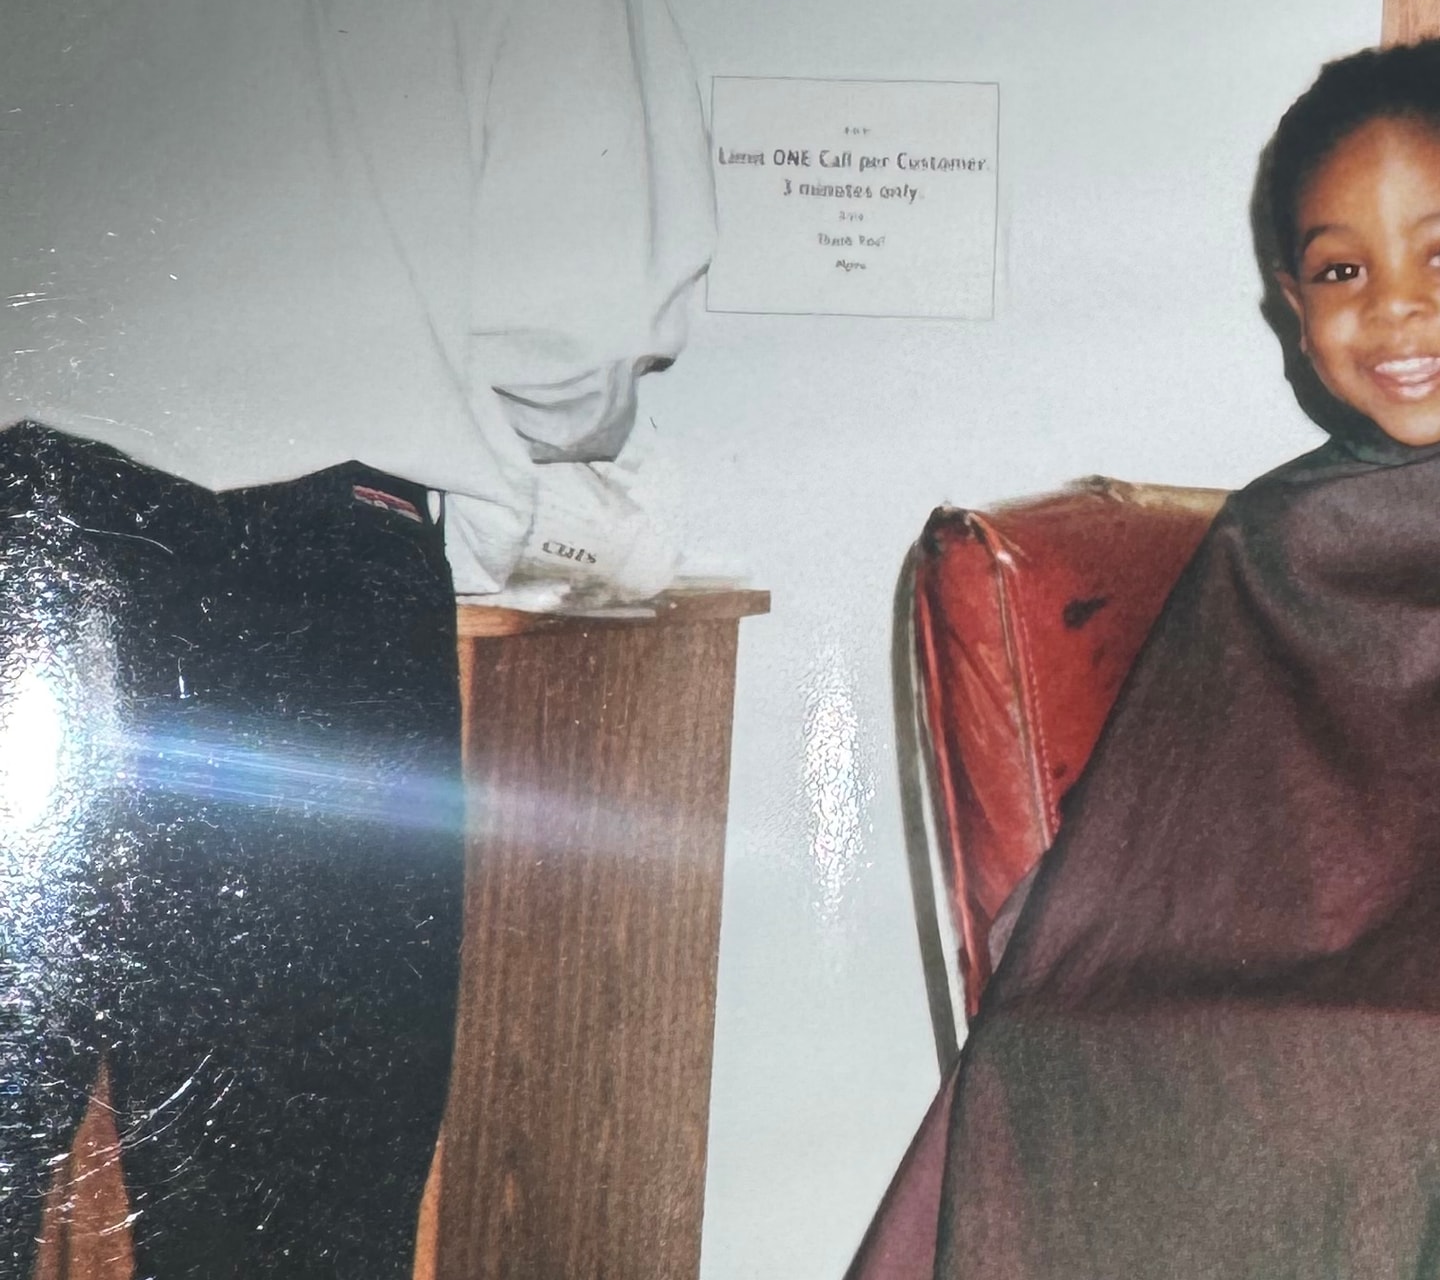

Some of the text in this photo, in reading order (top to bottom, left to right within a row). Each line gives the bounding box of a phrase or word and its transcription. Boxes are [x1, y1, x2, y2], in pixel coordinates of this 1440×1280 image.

[718, 146, 765, 167] Limit
[772, 148, 811, 168] ONE
[818, 149, 852, 169] Call
[858, 153, 889, 172] per
[783, 178, 793, 197] 3
[799, 182, 873, 199] minutes
